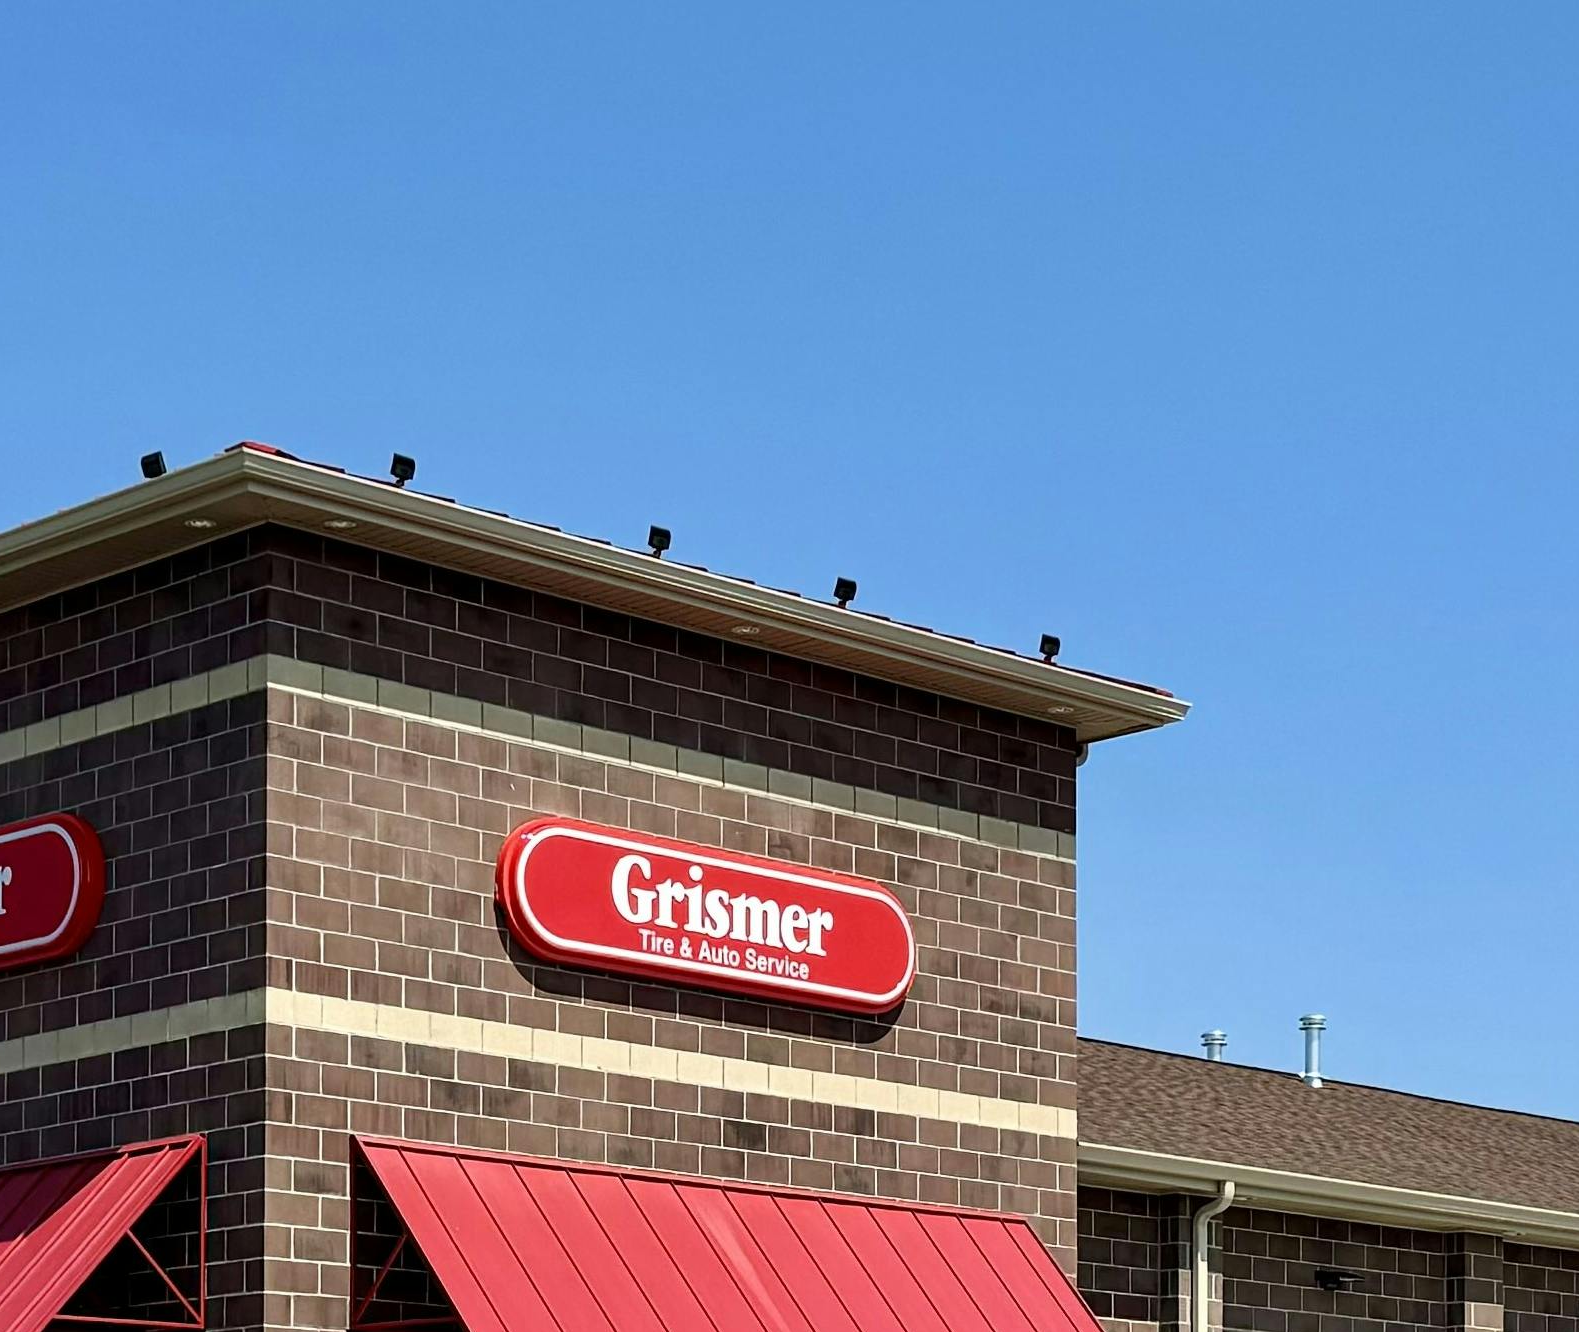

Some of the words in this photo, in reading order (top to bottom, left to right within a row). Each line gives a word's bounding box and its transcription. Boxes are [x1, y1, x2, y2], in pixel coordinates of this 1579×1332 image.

[611, 854, 833, 957] Grismer
[639, 928, 675, 956] Tire
[679, 936, 693, 959] &
[698, 940, 741, 967] Auto
[745, 947, 810, 981] Service
